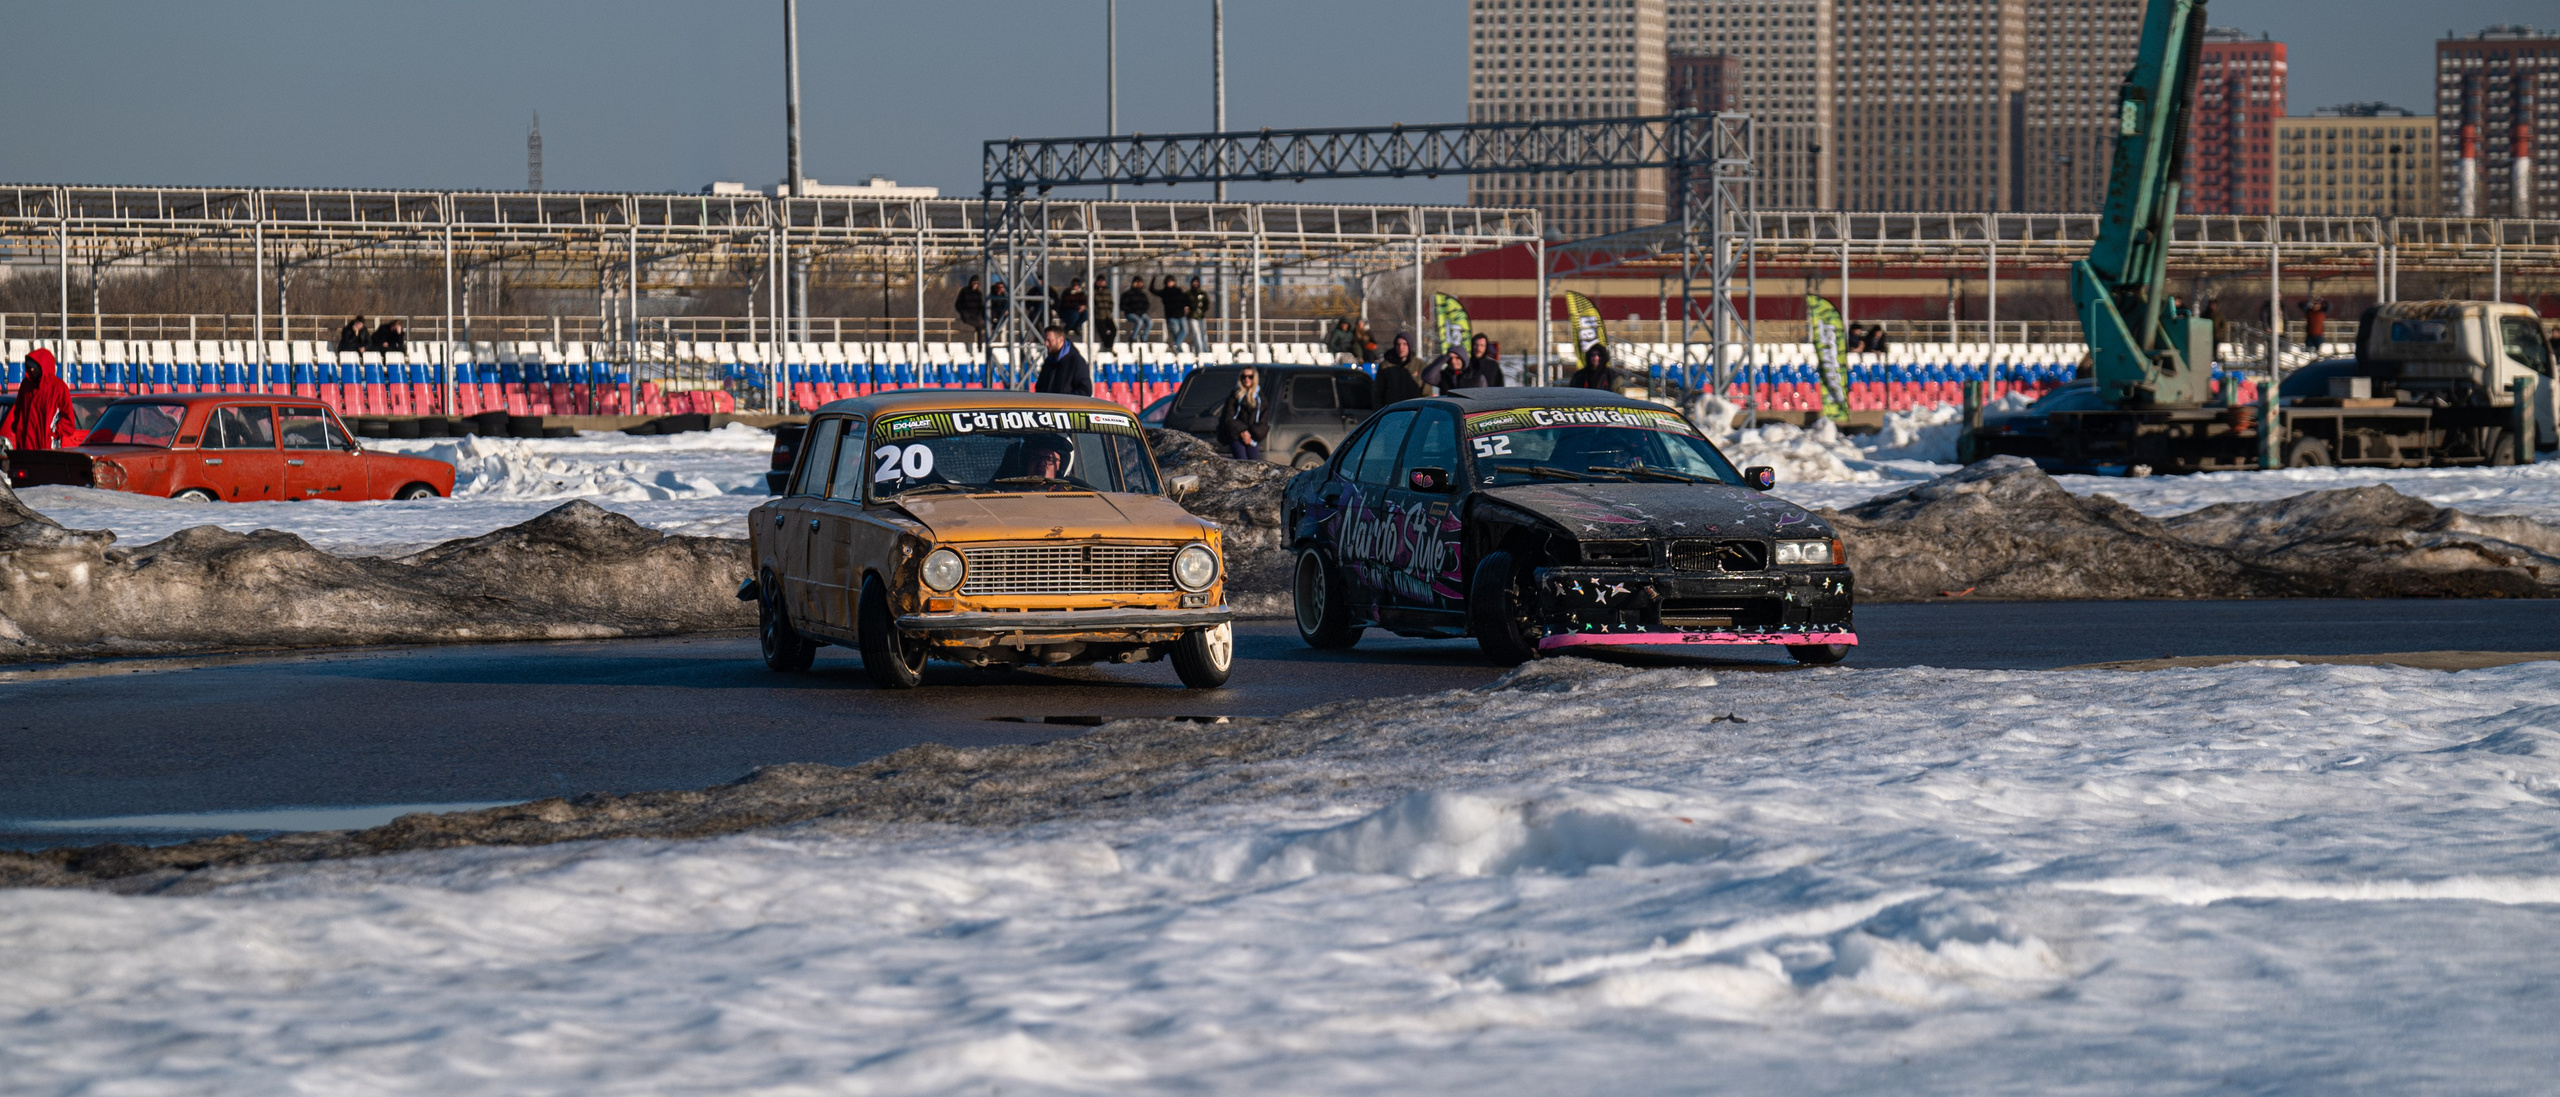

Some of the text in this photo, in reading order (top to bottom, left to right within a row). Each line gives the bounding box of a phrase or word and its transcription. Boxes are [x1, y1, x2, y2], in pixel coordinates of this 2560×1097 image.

[893, 419, 931, 431] EXHAUST
[1473, 434, 1512, 458] 52
[874, 444, 934, 483] 20
[1483, 475, 1495, 484] 2
[1338, 492, 1397, 567] Nardo
[1403, 501, 1446, 583] Style
